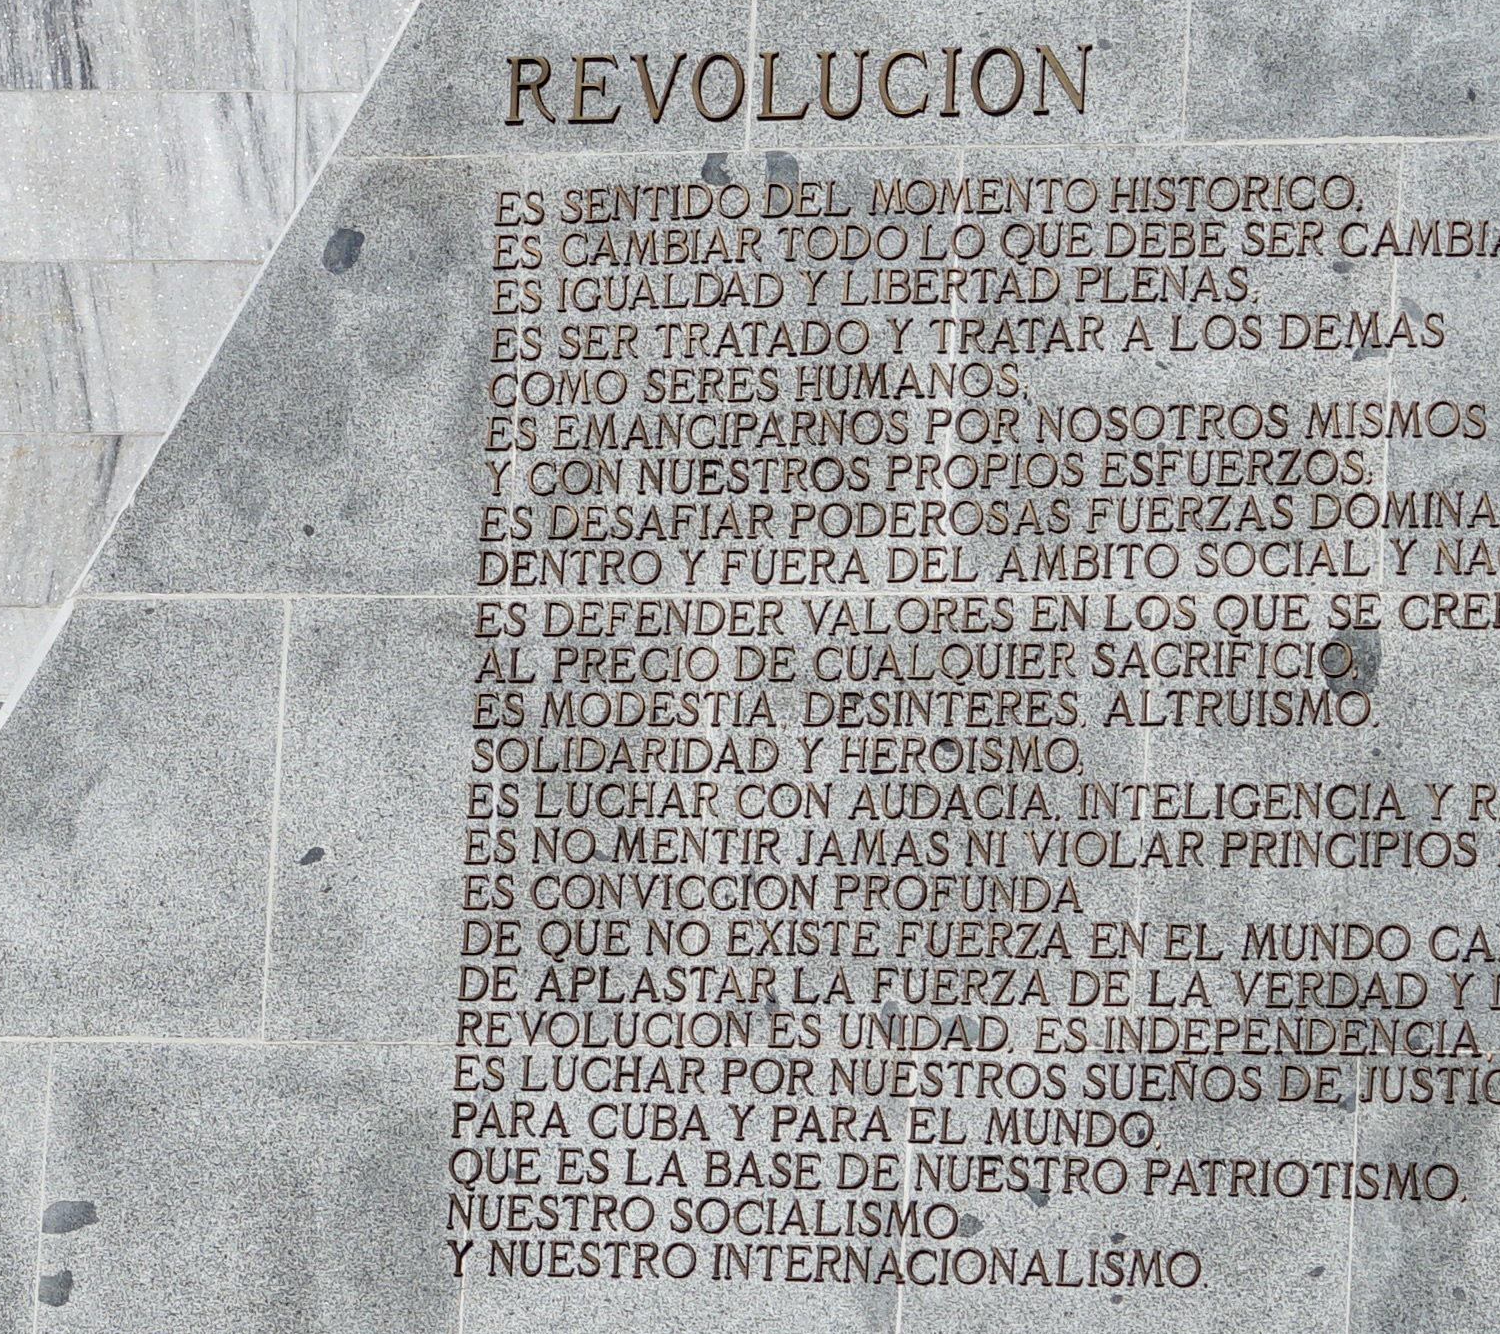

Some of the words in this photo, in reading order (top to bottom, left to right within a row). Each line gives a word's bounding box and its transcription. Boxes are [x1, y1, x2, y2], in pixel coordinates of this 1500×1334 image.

[506, 43, 1092, 124] REVOLUCION
[495, 189, 547, 227] ES
[559, 182, 752, 225] SENTIDO
[763, 179, 851, 219] DEL
[872, 176, 1100, 215] MOMENTO
[494, 233, 544, 270] ES
[560, 225, 763, 268] CAMBIAR
[779, 223, 910, 262] TODO
[921, 222, 987, 261] LO
[999, 221, 1094, 264] QUE
[1105, 220, 1226, 259] DEBE
[1242, 218, 1326, 259] SER
[492, 278, 545, 316] ES
[557, 270, 786, 313] IGUALDAD
[799, 269, 826, 307] Y
[841, 265, 1062, 306] LIBERTAD
[486, 368, 629, 408] COMO
[642, 365, 781, 405] SERES
[795, 360, 1038, 402] HUMANOS;
[485, 415, 539, 452] ES
[553, 408, 909, 452] EMANCIPARNOS
[926, 406, 1021, 445] POR
[1036, 401, 1290, 444] NOSOTROS
[1306, 399, 1488, 440] MISMOS
[478, 504, 534, 543] ES
[548, 501, 775, 542] DESAFIAR
[790, 496, 1072, 540] PODEROSAS
[1086, 492, 1295, 535] FUERZAS
[477, 548, 664, 588] DENTRO
[680, 548, 698, 586] Y
[721, 547, 870, 587] FUERA
[887, 545, 978, 585] DEL
[997, 541, 1181, 584] AMBITO
[1197, 538, 1370, 579] SOCIAL
[1390, 537, 1416, 577] Y
[474, 646, 534, 685] AL
[553, 644, 721, 685] PRECIO
[733, 644, 797, 683] DE
[811, 640, 1077, 684] CUALQUIER
[1092, 639, 1360, 680] SACRIFICIO;
[473, 690, 527, 729] ES
[541, 689, 785, 729] MODESTIA,
[802, 688, 1088, 729] DESINTERES,
[1104, 687, 1382, 729] ALTRUISMO,
[467, 781, 521, 820] ES
[534, 779, 720, 820] LUCHAR
[735, 781, 831, 820] CON
[850, 781, 1059, 821] AUDACIA,
[1078, 781, 1404, 822] INTELIGENCIA
[1426, 782, 1454, 820] Y
[464, 826, 518, 867] ES
[533, 826, 598, 864] NO
[614, 825, 780, 867] MENTIR
[798, 827, 951, 868] JAMAS
[966, 828, 1008, 868] NI
[1028, 829, 1205, 870] VIOLAR
[1221, 828, 1479, 870] PRINCIPIOS
[461, 918, 521, 959] DE
[536, 917, 632, 961] QUE
[647, 918, 712, 959] NO
[727, 918, 879, 959] EXISTE
[896, 919, 1071, 961] FUERZA
[1090, 919, 1150, 961] EN
[1164, 922, 1223, 963] EL
[1242, 922, 1413, 962] MUNDO
[456, 964, 518, 1003] DE
[536, 965, 778, 1005] APLASTAR
[793, 967, 854, 1004] LA
[872, 966, 1050, 1008] FUERZA
[1067, 968, 1131, 1009] DE
[1150, 970, 1212, 1008] LA
[1231, 969, 1430, 1010] VERDAD
[1447, 971, 1466, 1008] Y
[453, 1053, 506, 1093] ES
[521, 1055, 707, 1095] LUCHAR
[721, 1057, 815, 1097] POR
[831, 1058, 1068, 1100] NUESTROS
[1086, 1058, 1263, 1101] SUEÑOS
[1278, 1063, 1341, 1104] DE
[452, 1101, 569, 1139] PARA
[588, 1103, 709, 1142] CUBA
[730, 1103, 747, 1141] Y
[772, 1104, 892, 1144] PARA
[908, 1106, 967, 1146] EL
[986, 1107, 1160, 1149] MUNDO,
[448, 1239, 467, 1278] Y
[490, 1239, 698, 1281] NUESTRO
[713, 1242, 1209, 1289] INTERNACIONALISMO.
